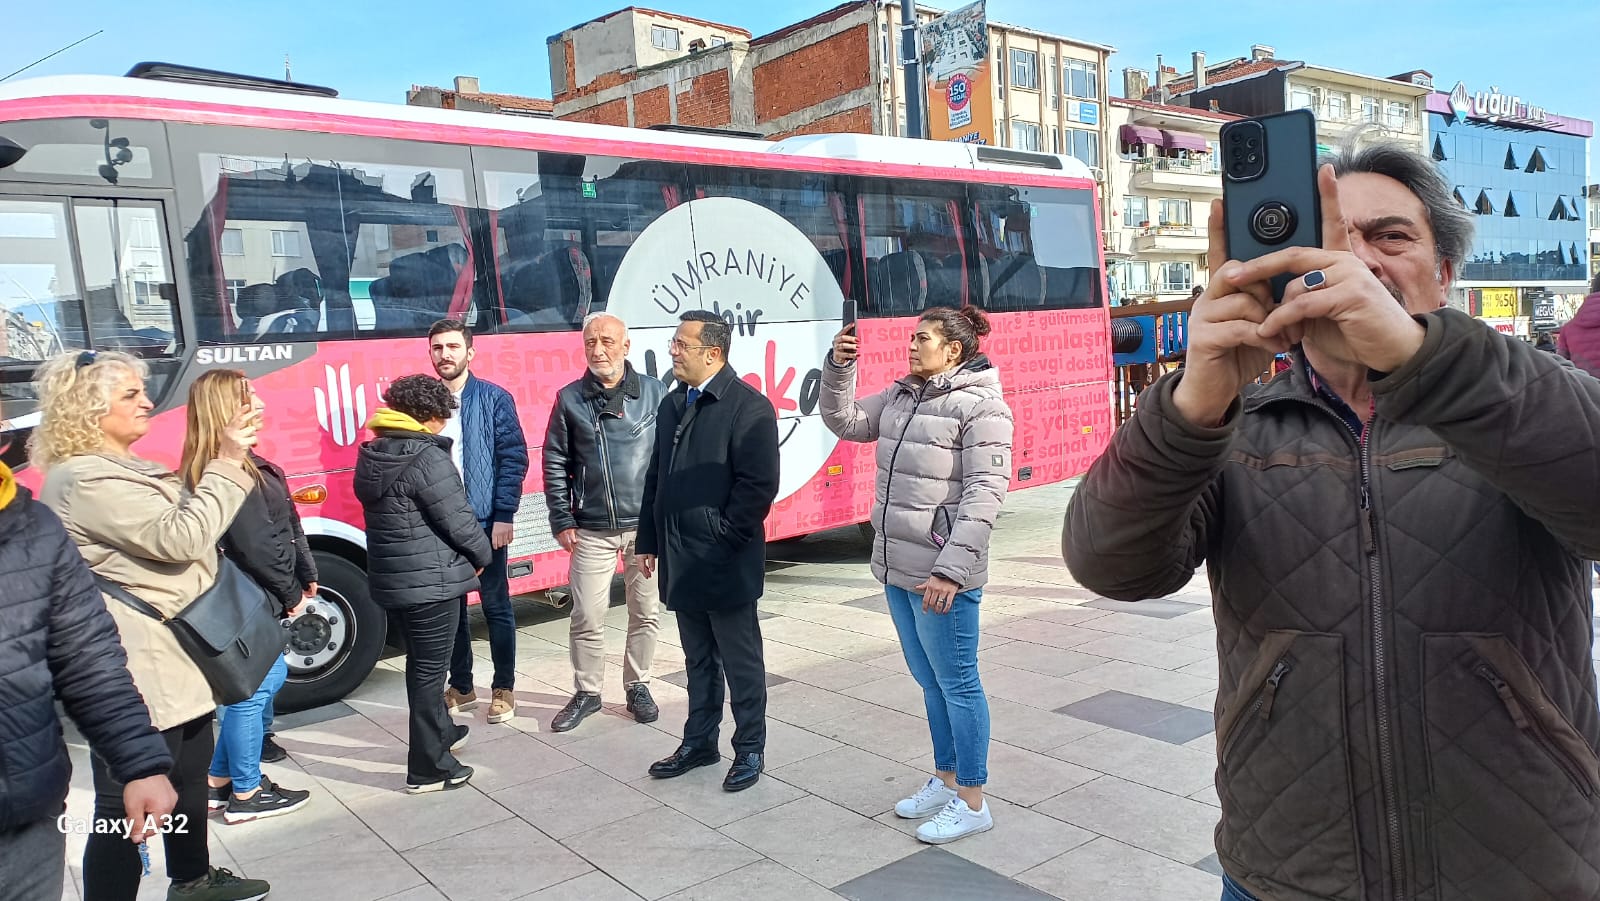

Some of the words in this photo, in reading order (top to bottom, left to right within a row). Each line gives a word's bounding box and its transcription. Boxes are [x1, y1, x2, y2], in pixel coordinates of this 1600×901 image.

[949, 82, 966, 96] 150
[196, 345, 293, 365] SULTAN
[1038, 437, 1088, 459] sanat
